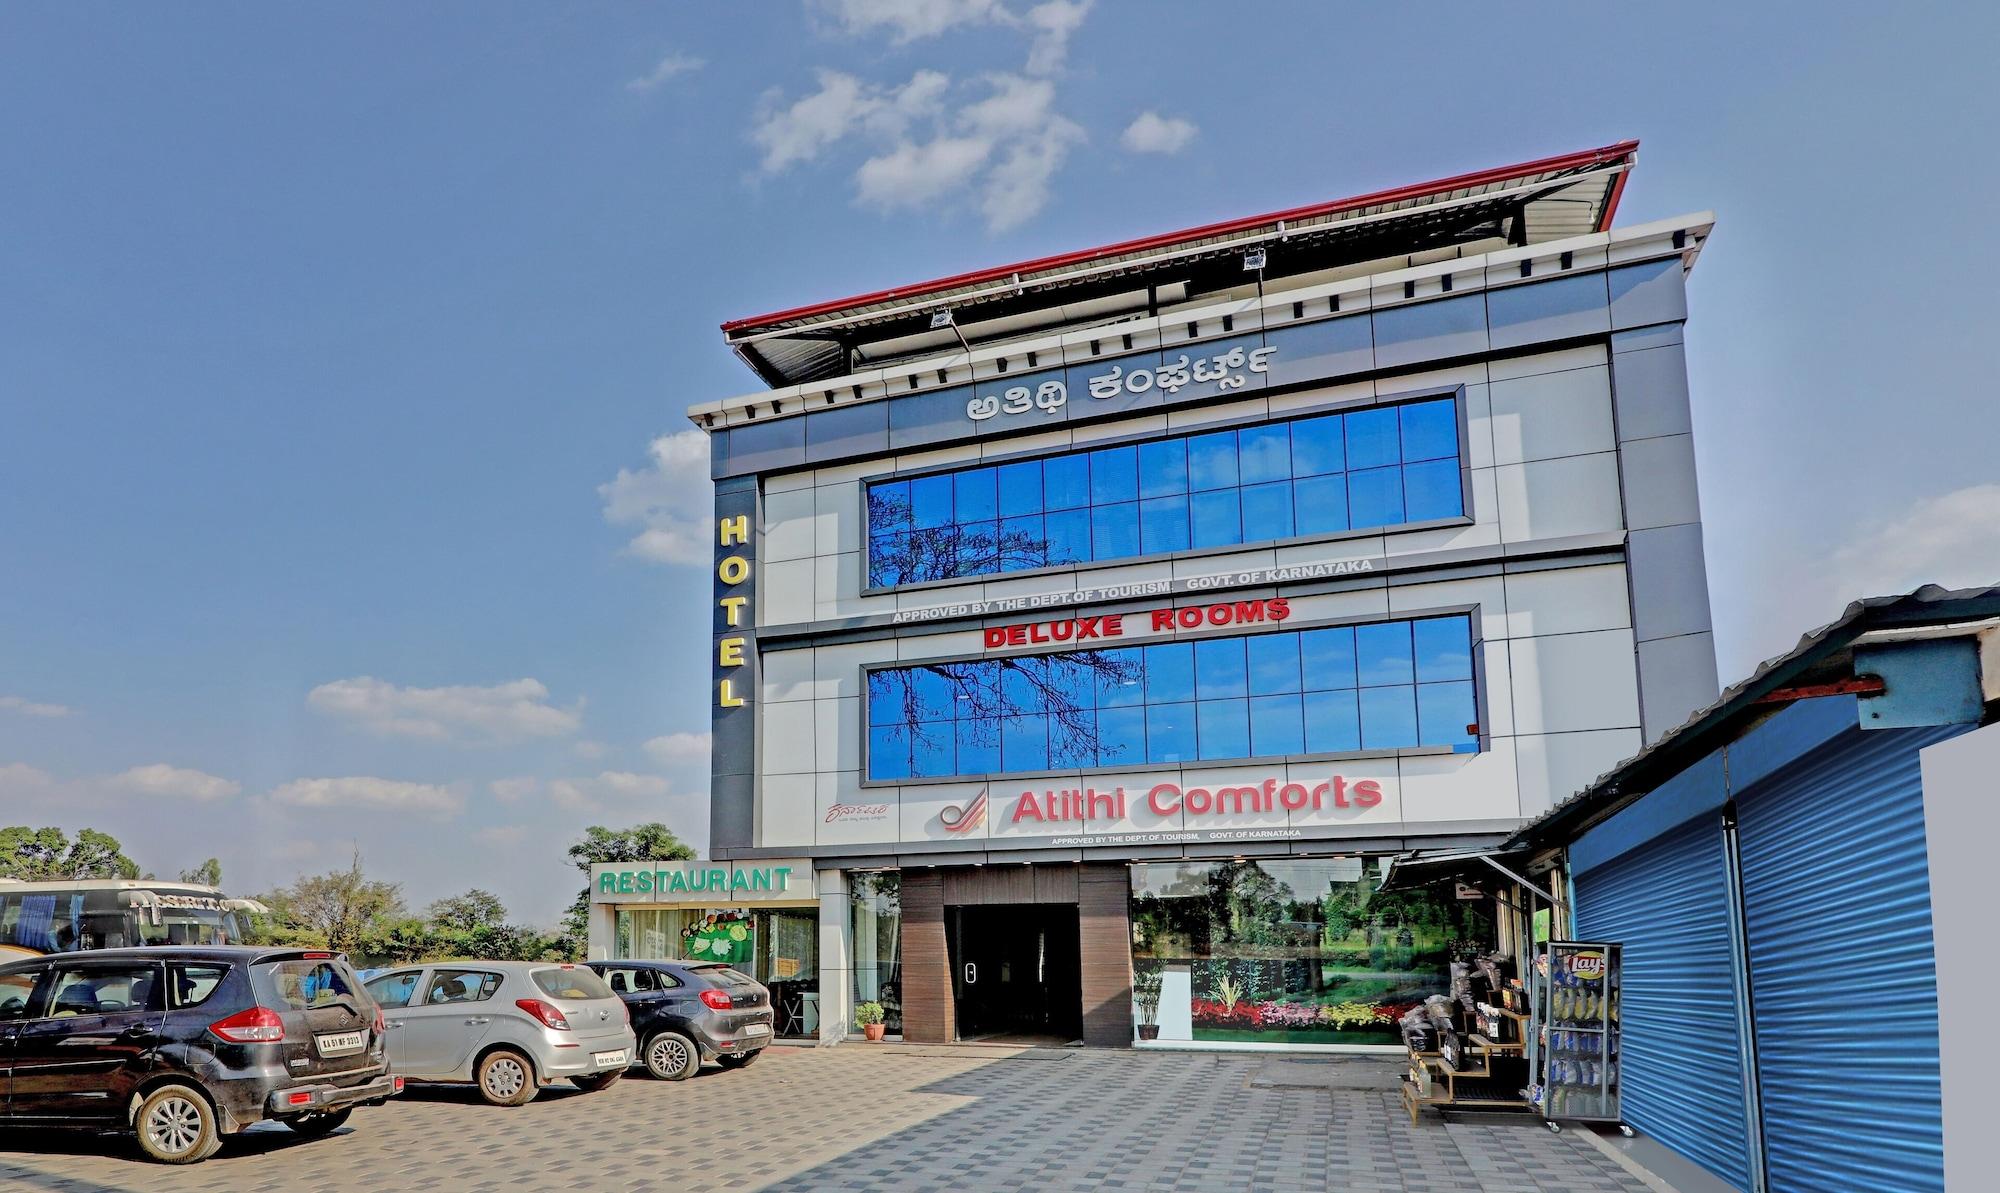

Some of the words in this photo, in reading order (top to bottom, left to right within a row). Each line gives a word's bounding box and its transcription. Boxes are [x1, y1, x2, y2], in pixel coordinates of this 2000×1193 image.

[966, 380, 1067, 420] ಅತಿಥಿ
[719, 515, 748, 708] HOTEL
[892, 606, 967, 624] APPROVED
[972, 601, 992, 613] BY
[996, 597, 1027, 611] THE
[1187, 575, 1234, 590] GOVT.
[1239, 571, 1260, 584] OF
[1265, 559, 1373, 582] KARNATAKA
[984, 614, 1123, 648] DELUXE
[1151, 597, 1290, 631] ROOMS
[1012, 787, 1126, 823] Atithi
[1148, 776, 1382, 817] Comforts
[1052, 837, 1094, 845] APPROVED
[1108, 835, 1123, 843] THE
[1149, 833, 1160, 841] OF
[1209, 831, 1234, 839] GOVT.
[1249, 829, 1301, 838] KARNATAKA
[599, 866, 793, 894] RESTAURANT
